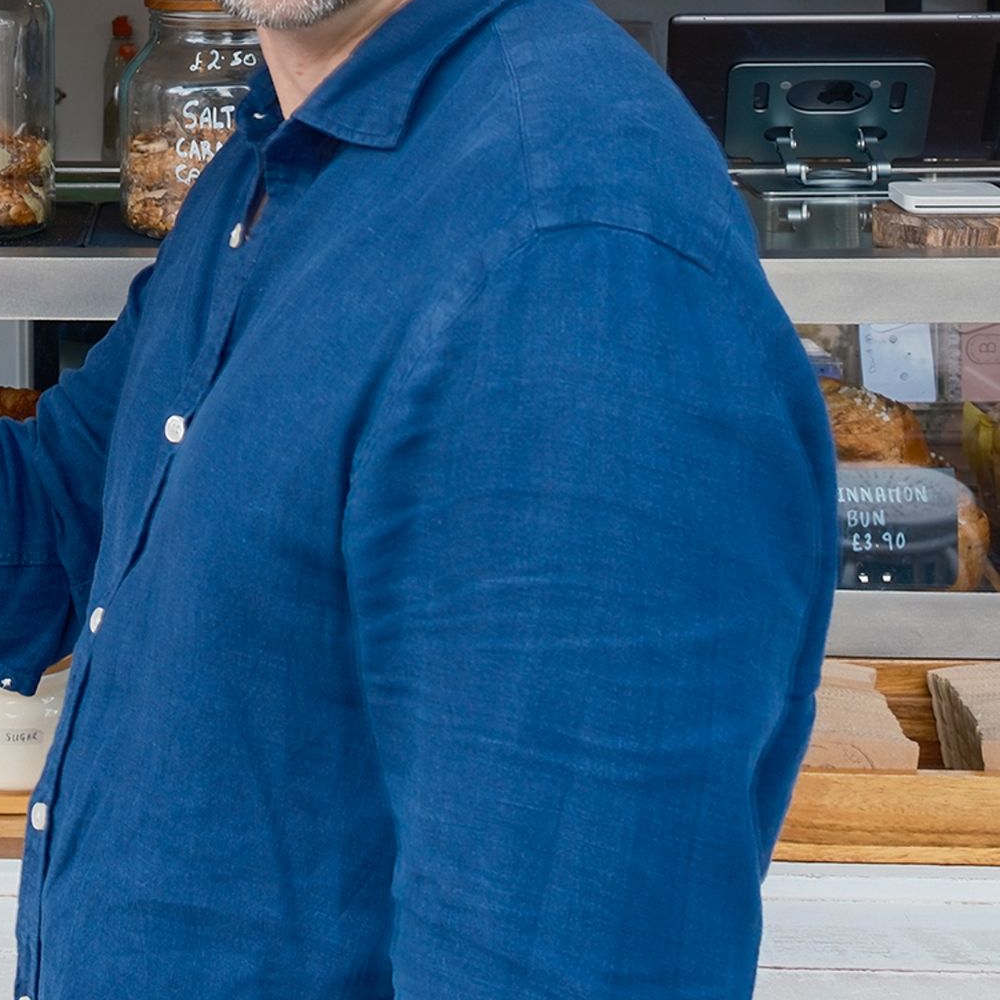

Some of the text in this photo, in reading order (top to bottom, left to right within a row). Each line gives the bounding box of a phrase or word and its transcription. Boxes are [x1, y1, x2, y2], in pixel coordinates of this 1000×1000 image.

[837, 486, 928, 503] INNAMON
[846, 509, 886, 528] BUN
[852, 531, 906, 552] £3.90
[5, 731, 40, 743] SUGAR
